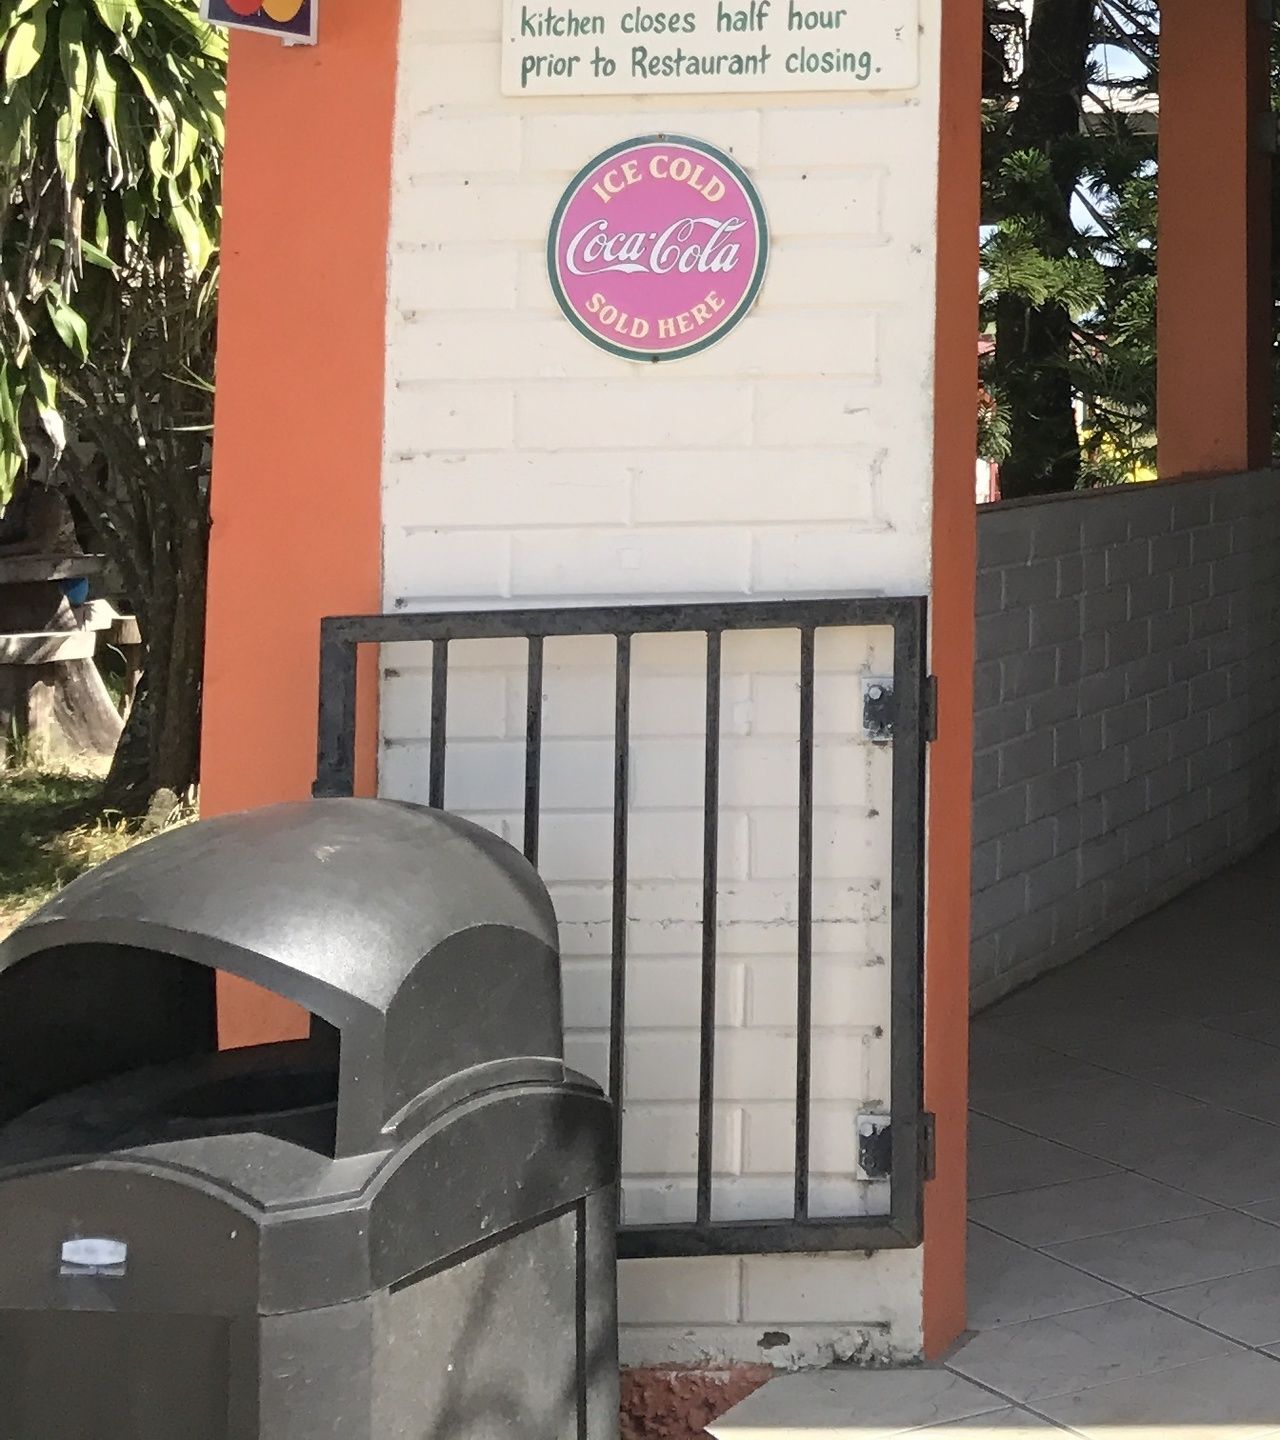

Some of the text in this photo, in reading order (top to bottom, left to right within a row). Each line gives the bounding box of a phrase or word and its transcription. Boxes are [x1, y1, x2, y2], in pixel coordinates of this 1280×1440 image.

[621, 6, 696, 34] closes
[716, 1, 771, 34] half
[788, 0, 847, 31] hour
[521, 45, 882, 88] prior to Restaurant closing.
[592, 155, 726, 204] ICE COLD
[585, 290, 725, 339] SOLD HERE
